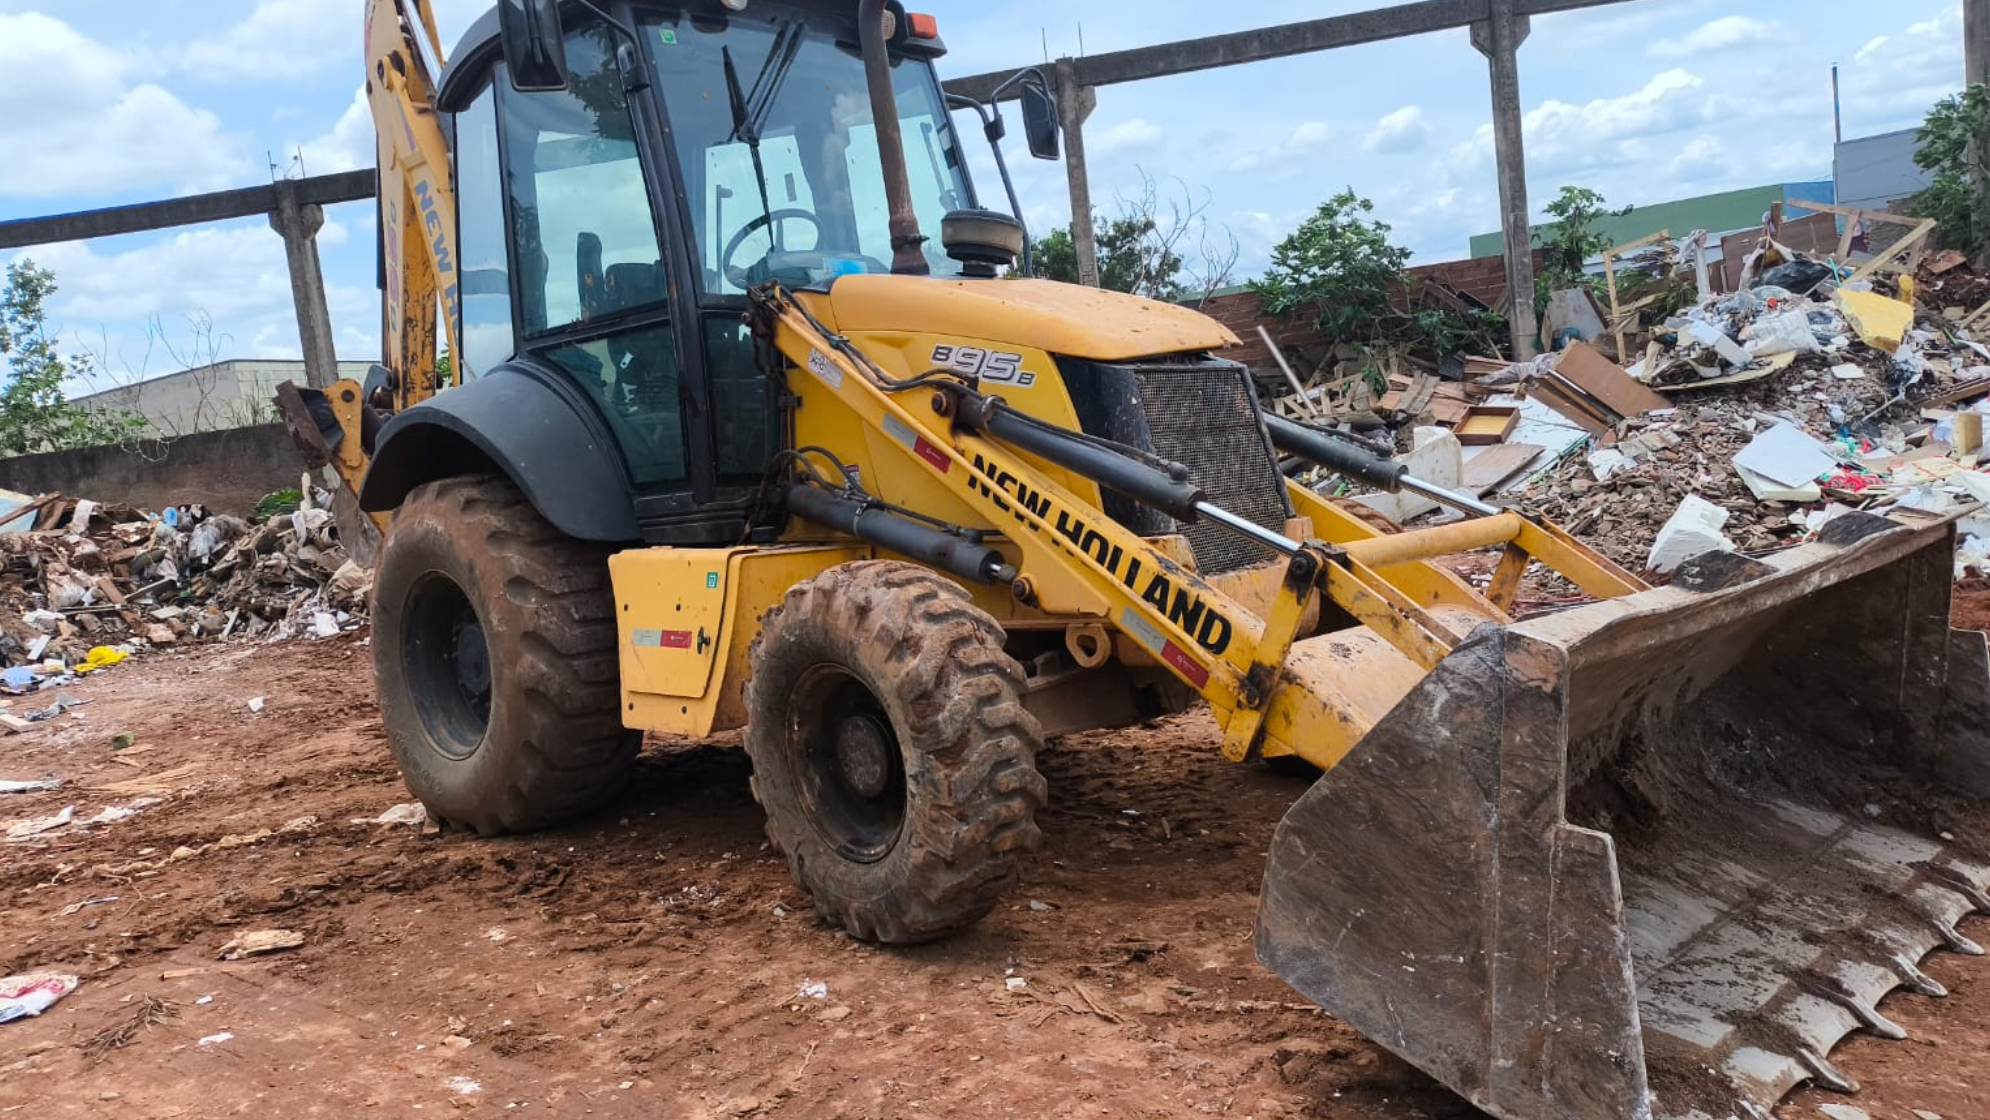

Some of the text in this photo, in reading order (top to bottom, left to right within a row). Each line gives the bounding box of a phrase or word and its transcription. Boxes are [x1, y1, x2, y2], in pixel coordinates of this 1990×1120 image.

[414, 179, 453, 274] NEW
[967, 453, 1233, 656] NEW HOLLAND
